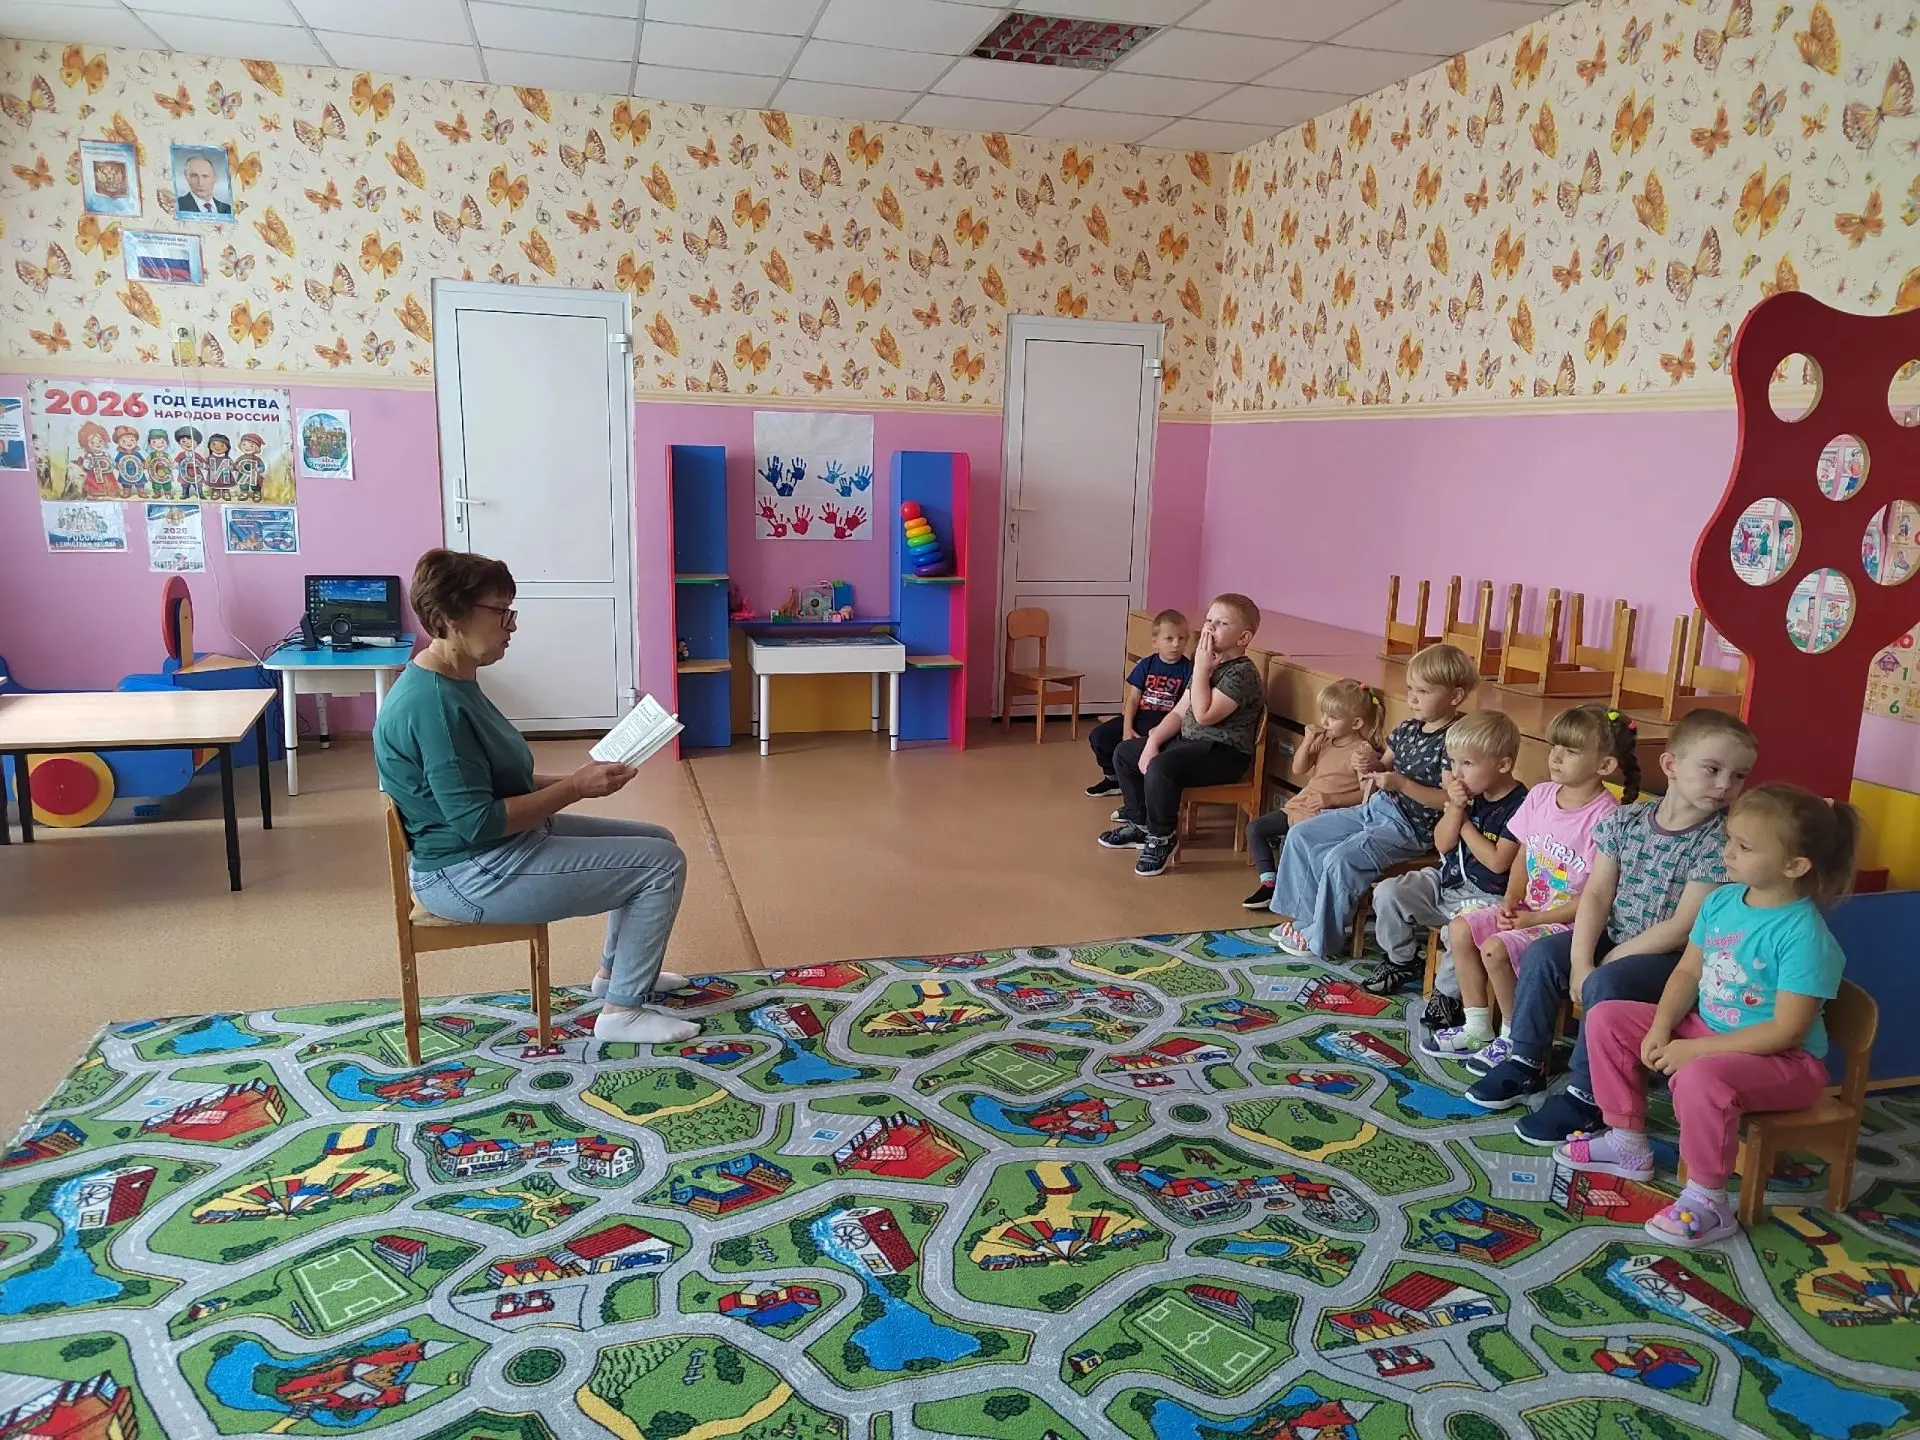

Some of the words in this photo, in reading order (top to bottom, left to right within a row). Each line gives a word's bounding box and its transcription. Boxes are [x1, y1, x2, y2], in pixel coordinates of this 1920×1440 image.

[44, 389, 149, 417] 2026
[153, 394, 186, 407] ГОД
[191, 396, 280, 409] ЕДИНСТВА
[154, 410, 222, 421] НАРОДОВ
[226, 412, 280, 422] РОССИИ
[90, 456, 259, 487] РОССИЯ
[163, 527, 188, 535] 2026
[1902, 666, 1909, 681] 1
[1889, 700, 1900, 714] 6
[1543, 833, 1587, 874] Cream
